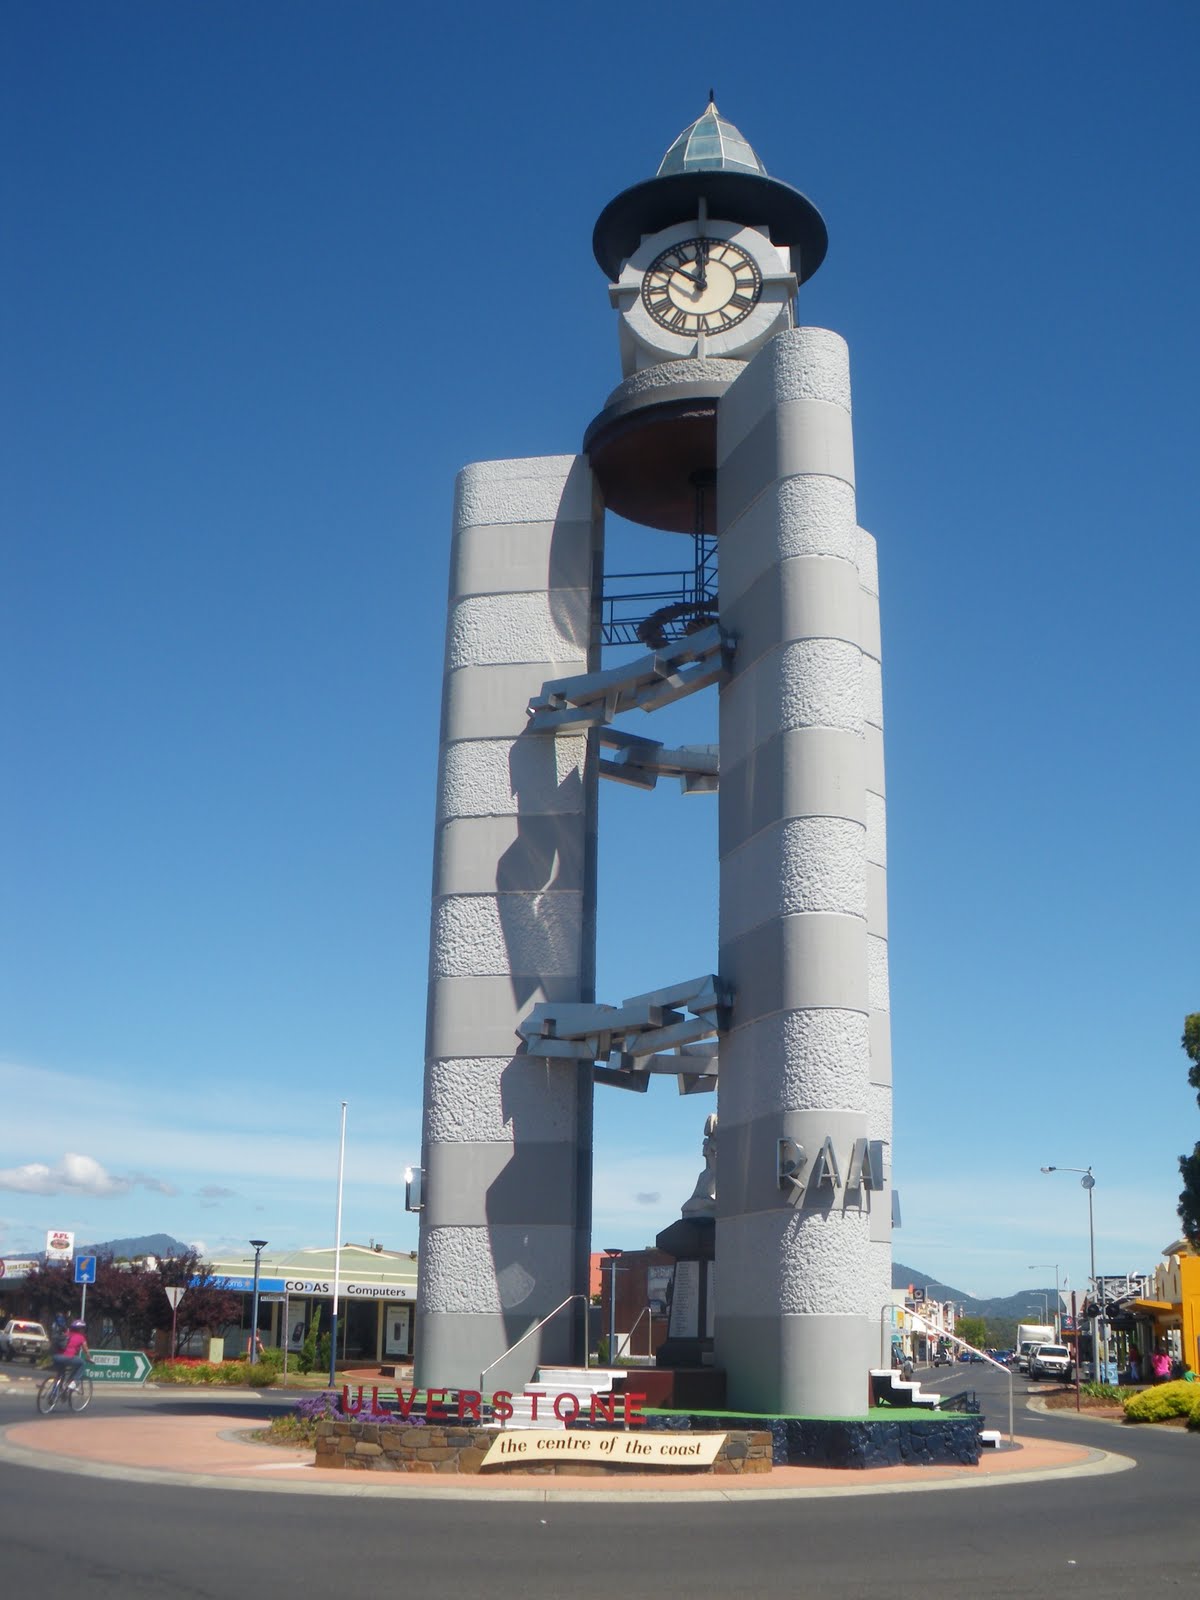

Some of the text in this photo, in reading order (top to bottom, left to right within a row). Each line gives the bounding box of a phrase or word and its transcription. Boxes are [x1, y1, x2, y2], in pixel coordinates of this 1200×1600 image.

[53, 1232, 69, 1240] AFL
[285, 1281, 406, 1297] CODAS Computers
[86, 1369, 131, 1379] Town Centre
[342, 1384, 648, 1425] ULVERSTONE
[500, 1436, 702, 1456] the centre of the coast
